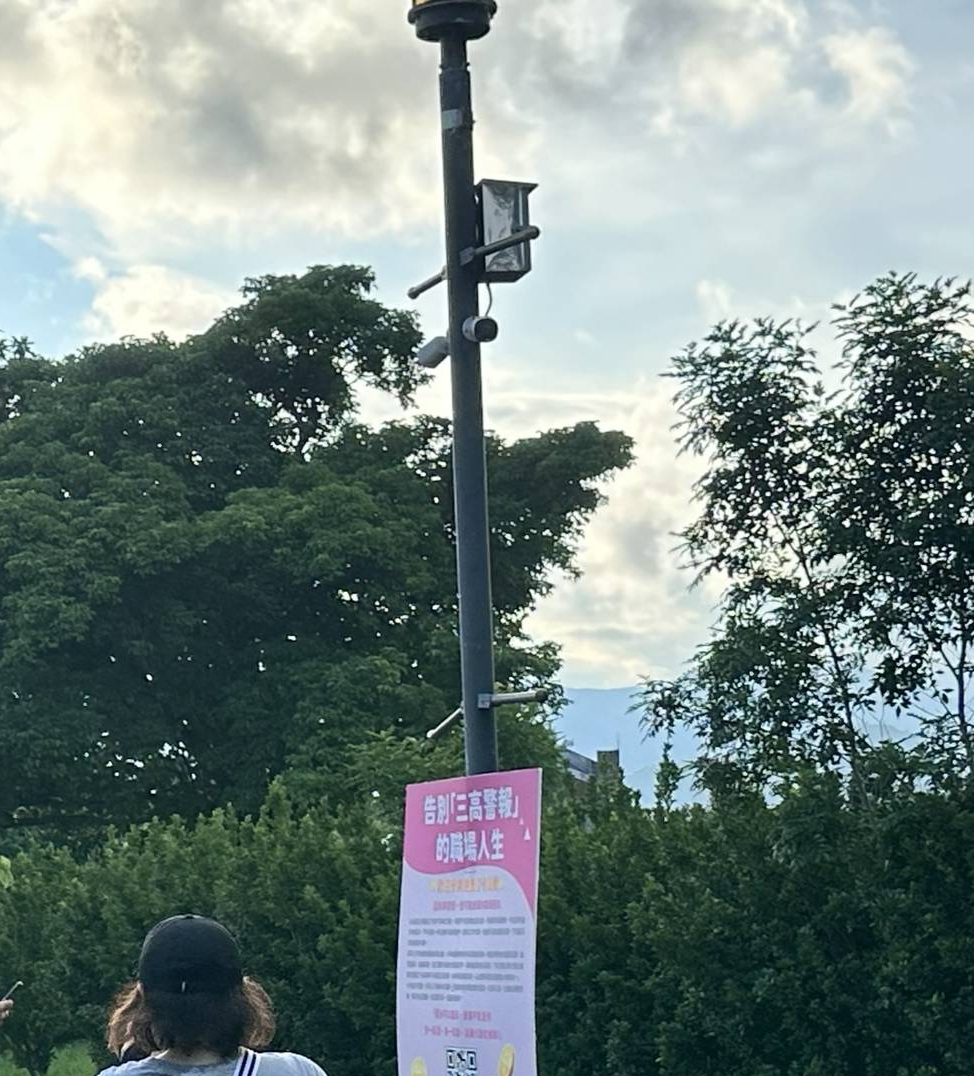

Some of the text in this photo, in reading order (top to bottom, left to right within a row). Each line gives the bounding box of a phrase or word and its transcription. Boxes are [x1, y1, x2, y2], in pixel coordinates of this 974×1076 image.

[424, 786, 519, 825] 告別「三高警報」
[436, 827, 505, 864] 的職場人生
